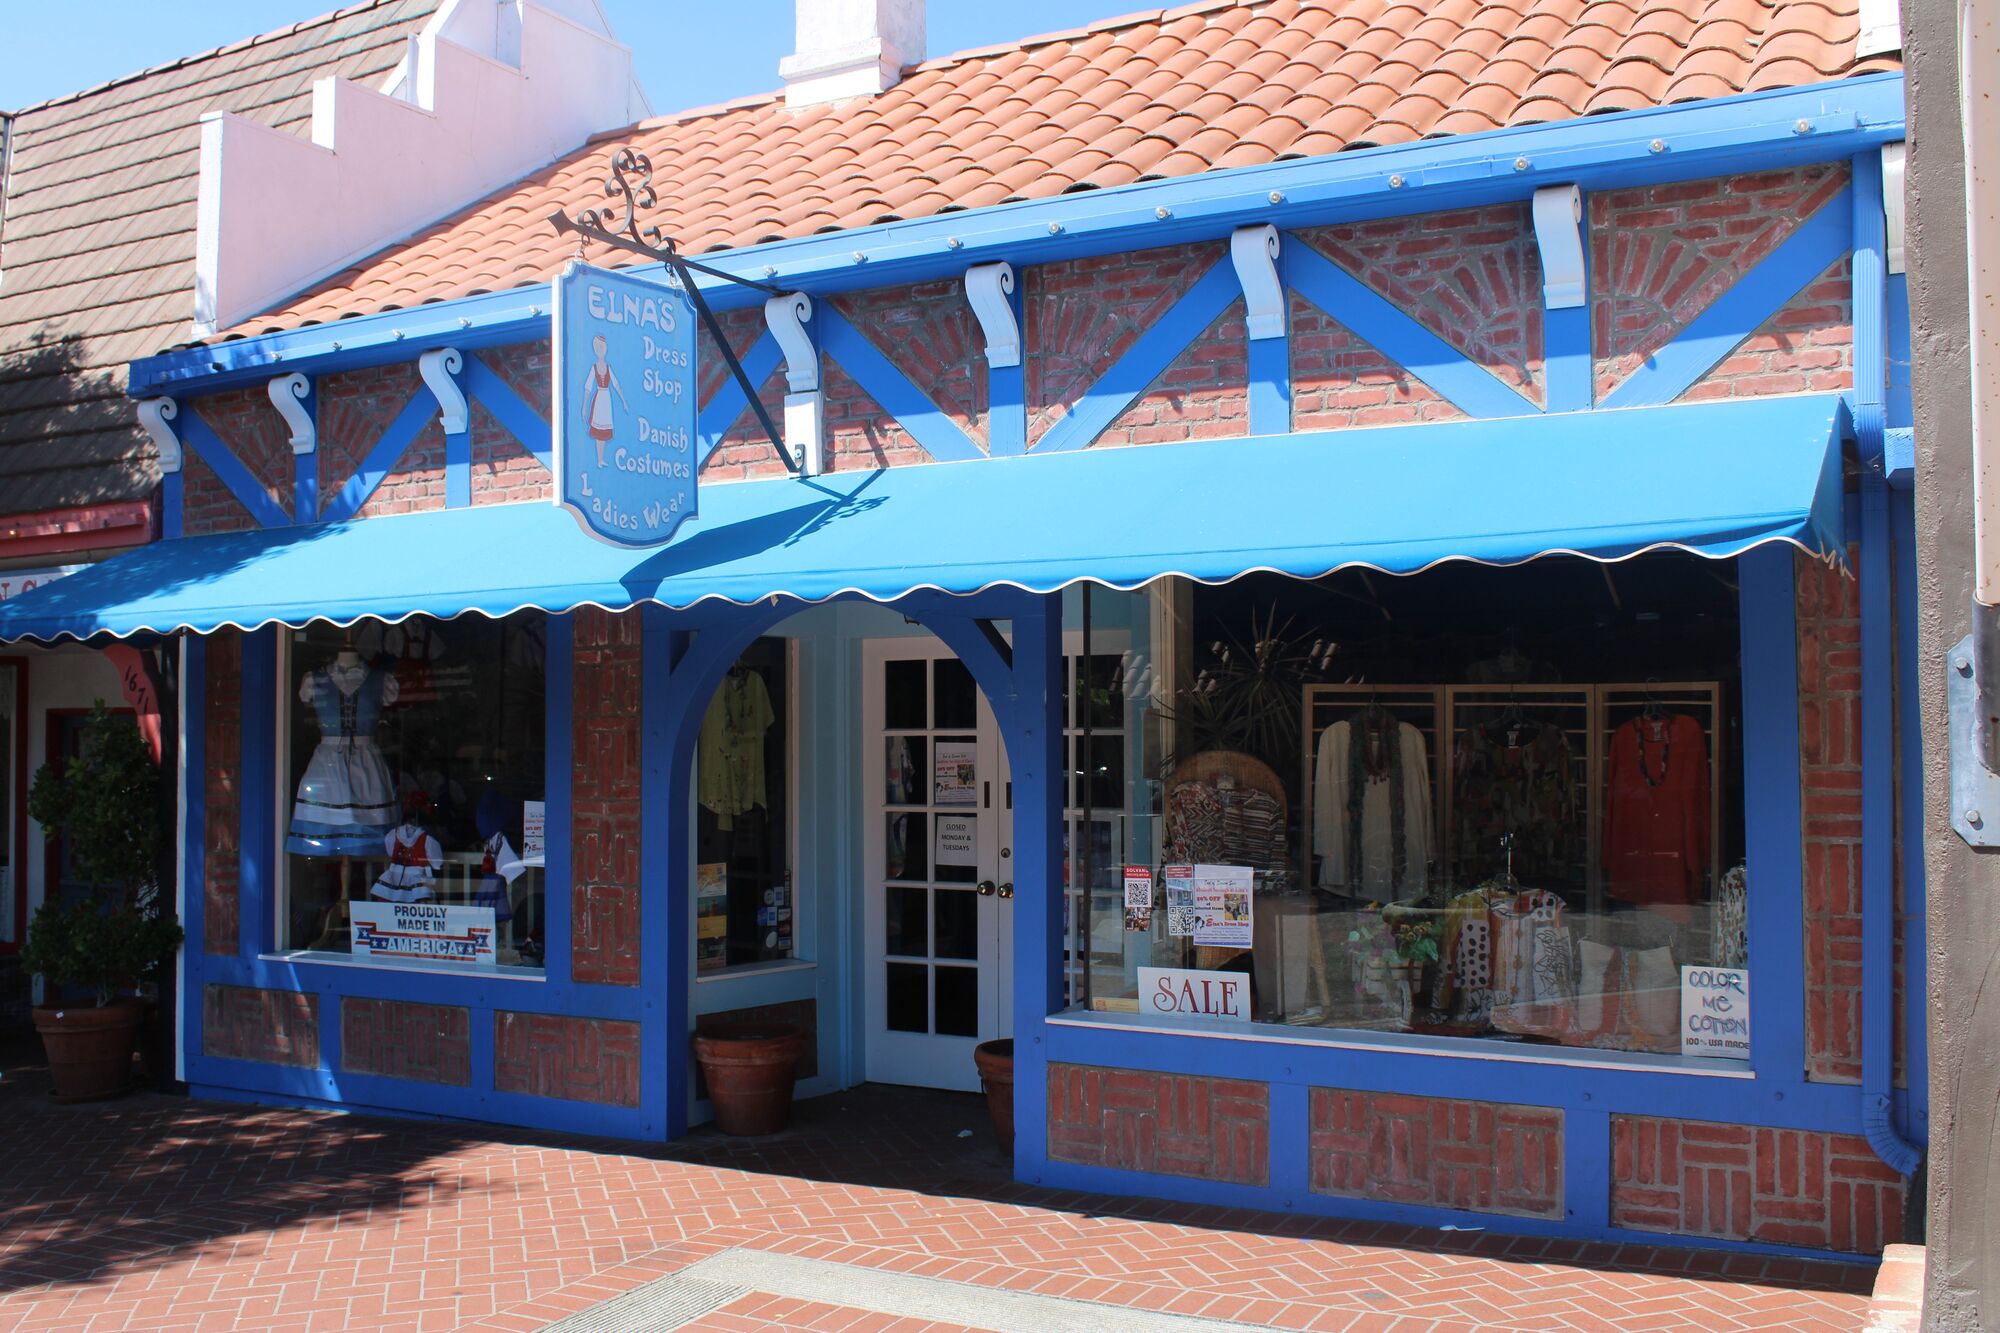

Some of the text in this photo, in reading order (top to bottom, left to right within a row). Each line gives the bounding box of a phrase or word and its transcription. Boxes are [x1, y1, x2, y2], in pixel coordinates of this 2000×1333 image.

[588, 285, 676, 333] ELNA'S
[643, 335, 688, 368] Dress
[643, 368, 682, 404] Shop
[638, 416, 689, 453] Danish
[614, 448, 690, 479] Costumes
[580, 472, 686, 530] Ladies Wear
[124, 665, 149, 714] 1671
[945, 823, 967, 831] CLOSED
[394, 905, 447, 919] PROUDLY
[397, 919, 446, 932] MADE IN
[387, 938, 458, 955] AMERICA
[1153, 976, 1239, 1018] SALE
[1689, 970, 1745, 995] COLOR
[1689, 1015, 1748, 1036] COTTON
[1708, 1039, 1723, 1048] USA
[1724, 1040, 1750, 1050] MADE
